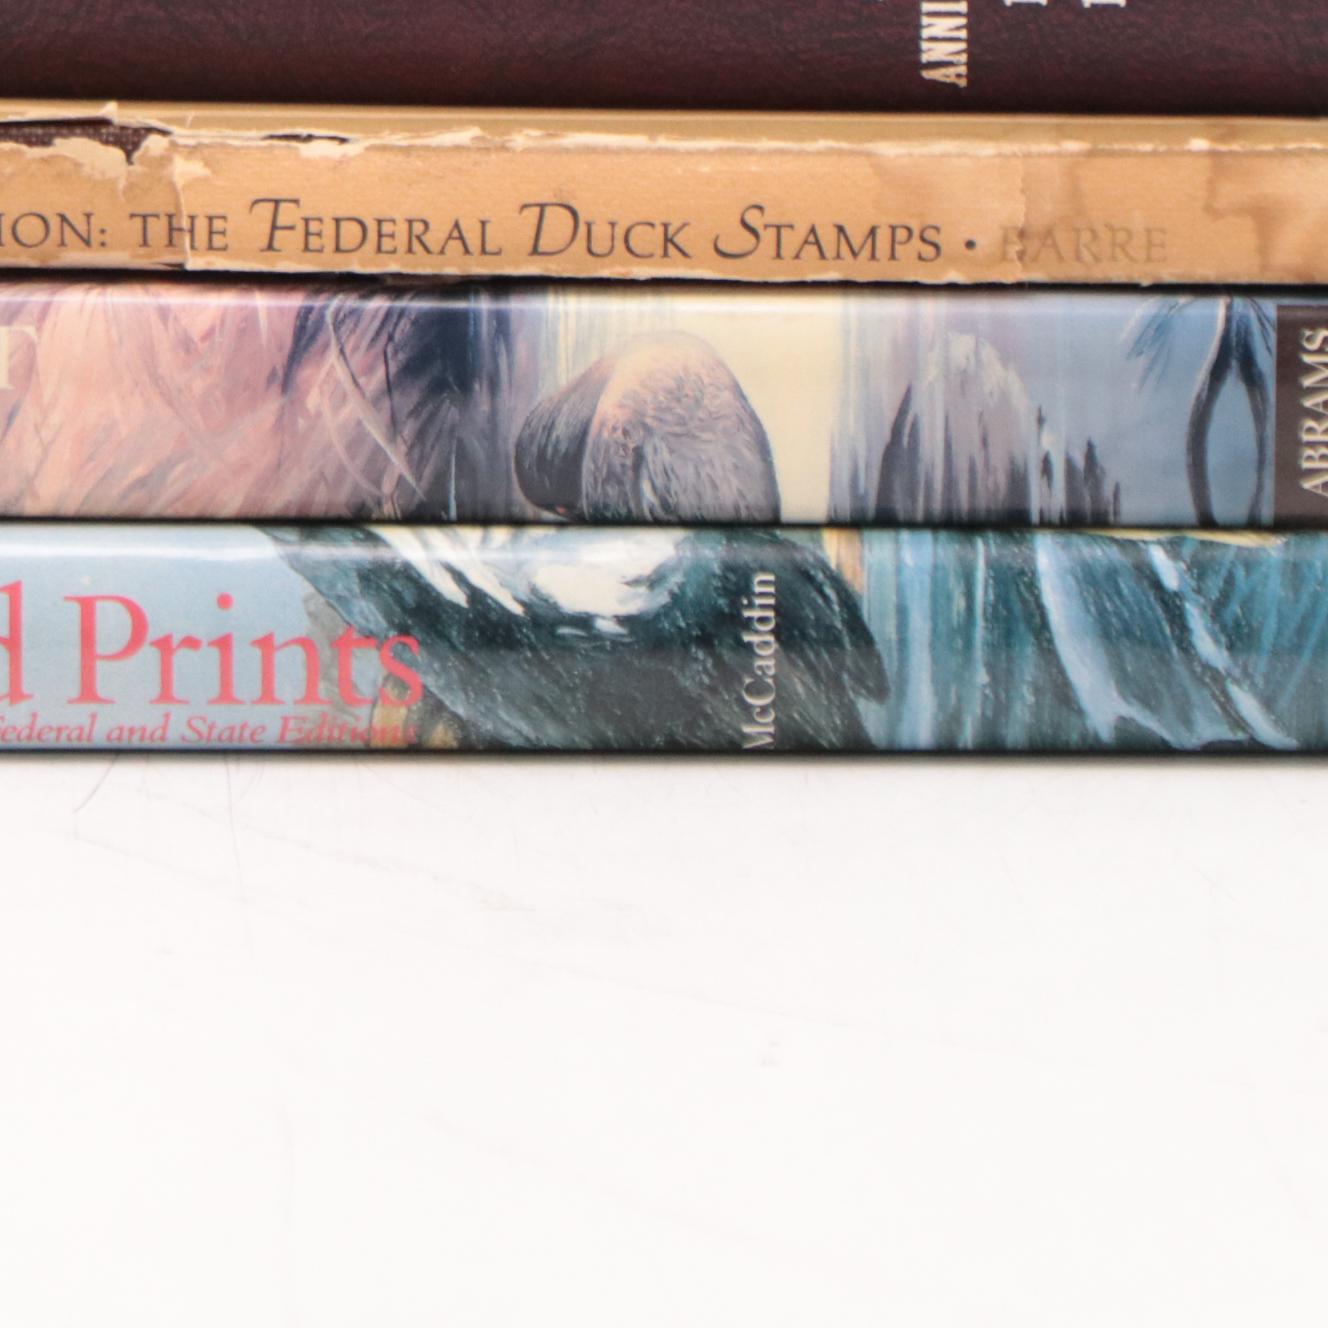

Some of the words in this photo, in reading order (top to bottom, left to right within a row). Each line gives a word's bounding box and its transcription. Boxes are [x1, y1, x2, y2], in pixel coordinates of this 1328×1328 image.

[129, 211, 228, 252] THE
[249, 197, 502, 258] FEDERAL
[518, 201, 692, 261] DUCK
[1299, 328, 1328, 498] ABRAMS
[64, 591, 424, 709] Prints
[740, 572, 776, 750] McCaddin
[106, 712, 173, 744] and
[180, 714, 266, 744] State
